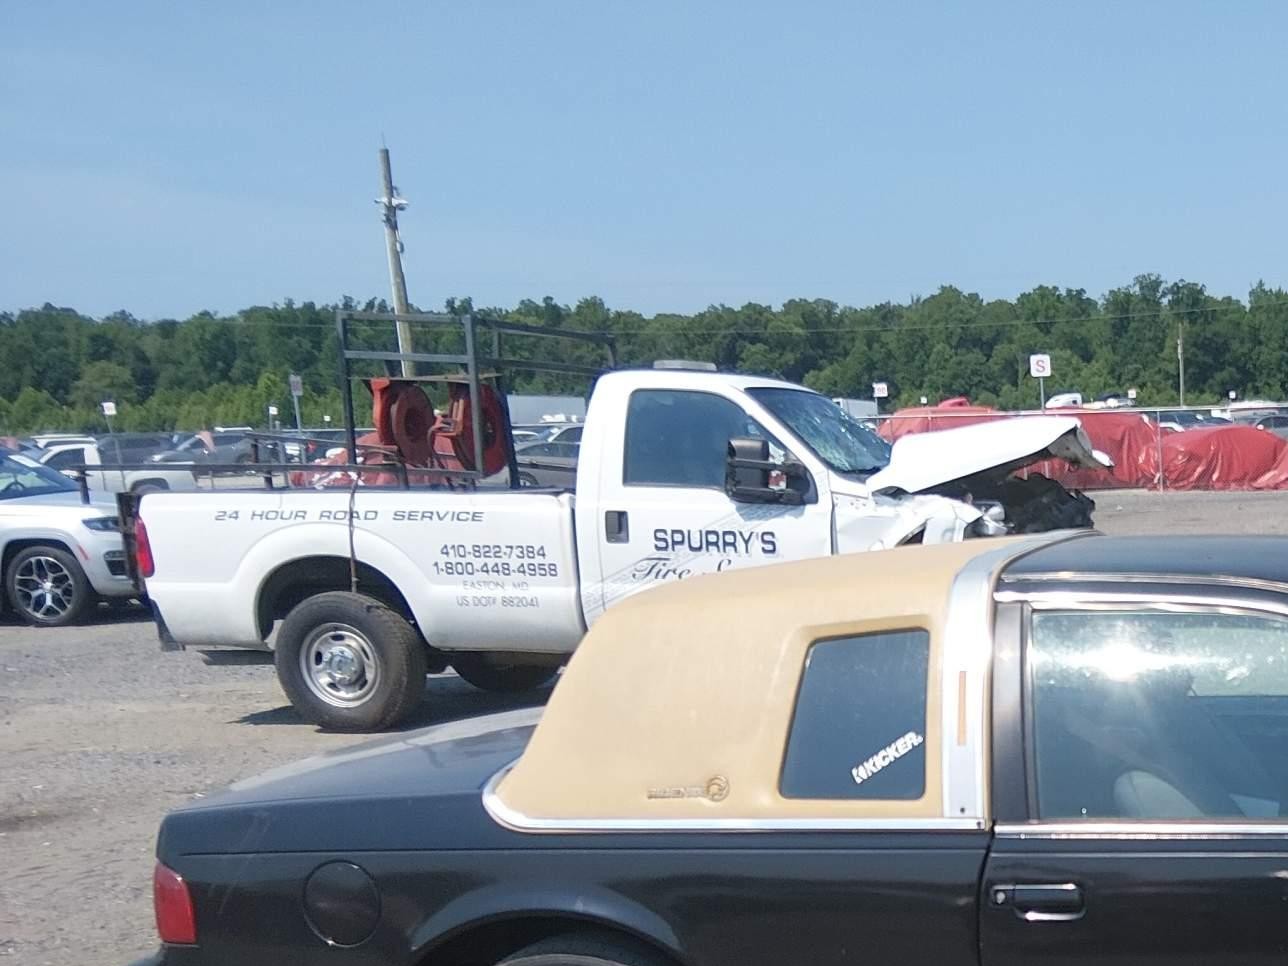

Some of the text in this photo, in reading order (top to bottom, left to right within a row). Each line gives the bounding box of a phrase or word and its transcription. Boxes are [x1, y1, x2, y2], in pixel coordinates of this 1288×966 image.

[1035, 359, 1046, 373] S
[214, 510, 485, 522] 24 HOUR ROAD SERVICE
[653, 528, 777, 554] SPURRY'S
[440, 544, 546, 559] 410-822-7384
[433, 561, 558, 577] 1-800-448-4958
[632, 557, 691, 580] Tire
[456, 596, 470, 607] US
